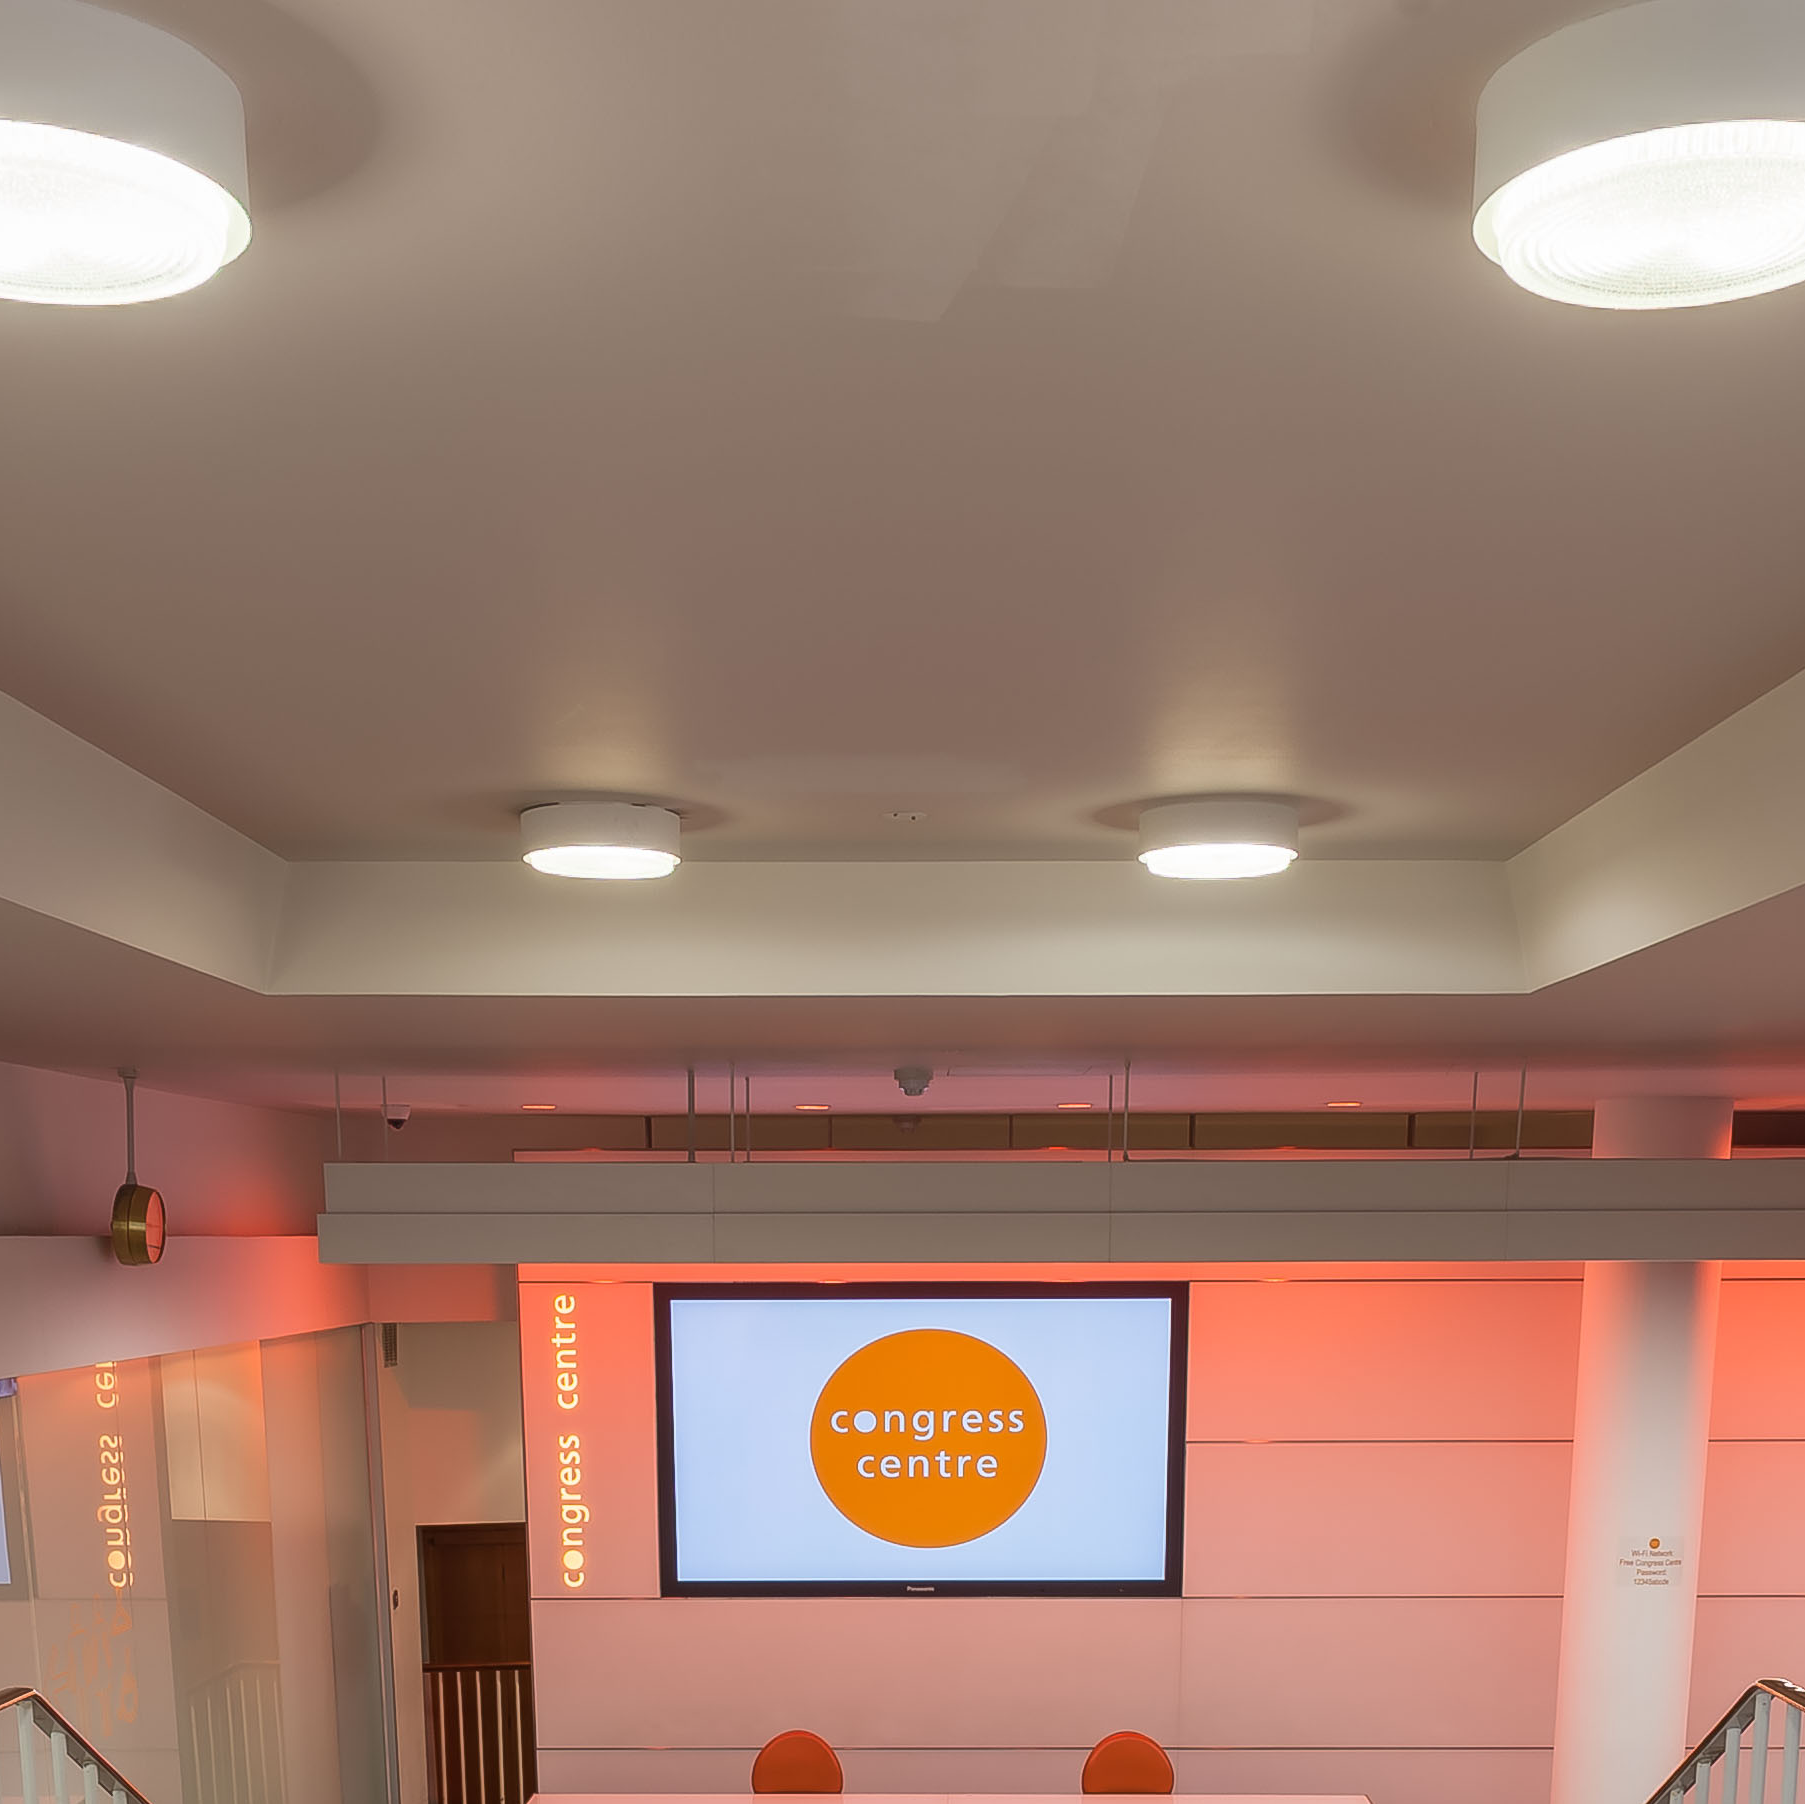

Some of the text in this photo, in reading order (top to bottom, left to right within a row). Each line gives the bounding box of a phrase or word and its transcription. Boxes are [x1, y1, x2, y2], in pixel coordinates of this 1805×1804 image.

[551, 1293, 590, 1589] congress centre
[830, 1409, 1025, 1441] congress
[856, 1450, 998, 1478] centre
